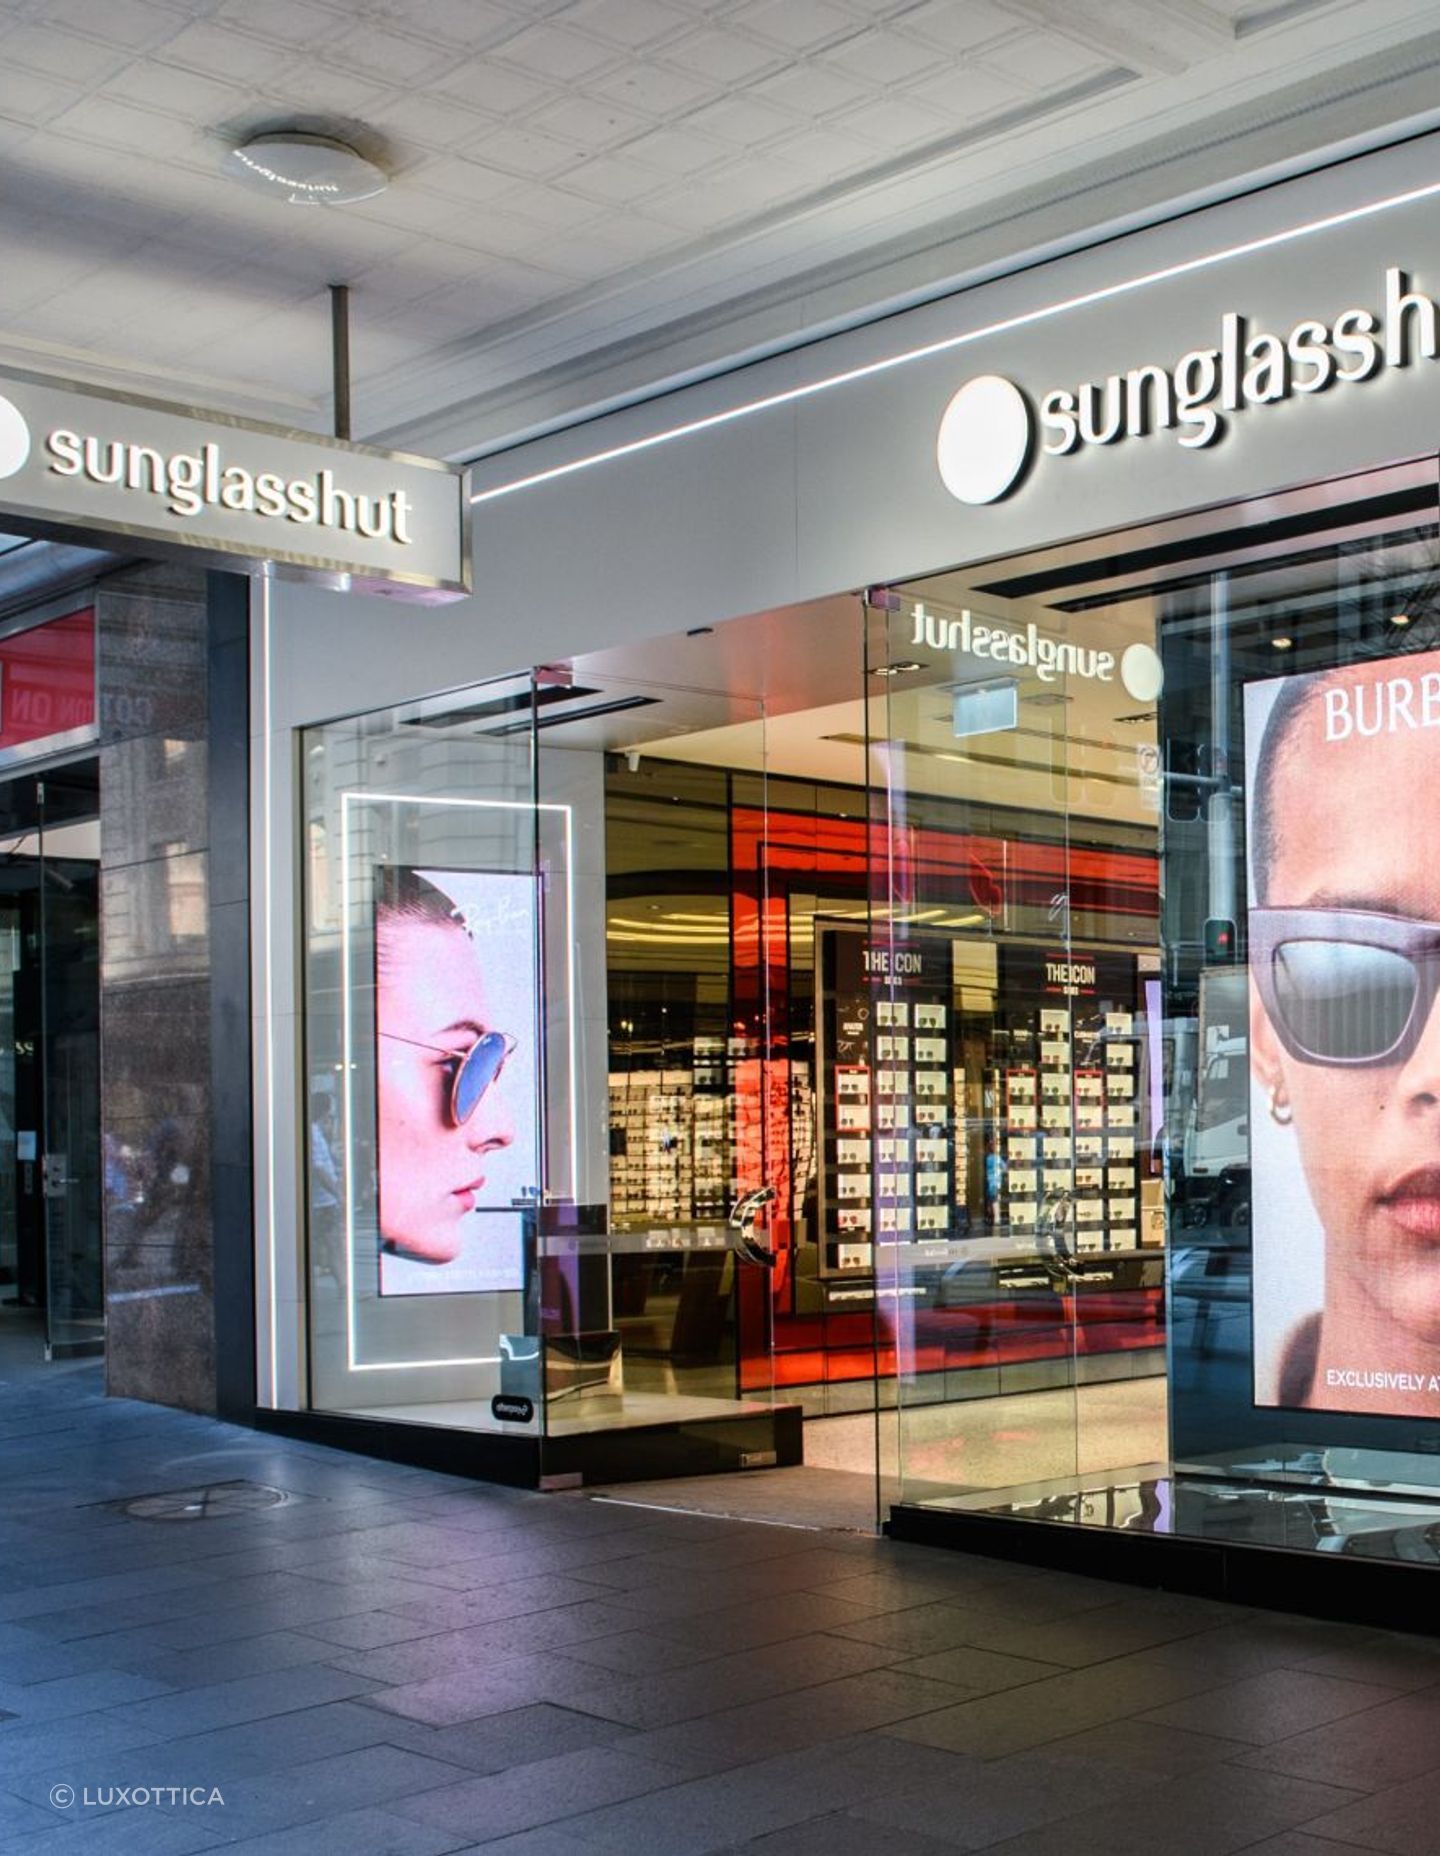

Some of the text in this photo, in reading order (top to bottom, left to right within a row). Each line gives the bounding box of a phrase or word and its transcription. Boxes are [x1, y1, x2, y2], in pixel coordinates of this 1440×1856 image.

[46, 428, 413, 546] sunglasshut
[890, 953, 923, 973] CON
[1045, 963, 1067, 983] THE
[1326, 1368, 1425, 1391] EXCLUSIVELY
